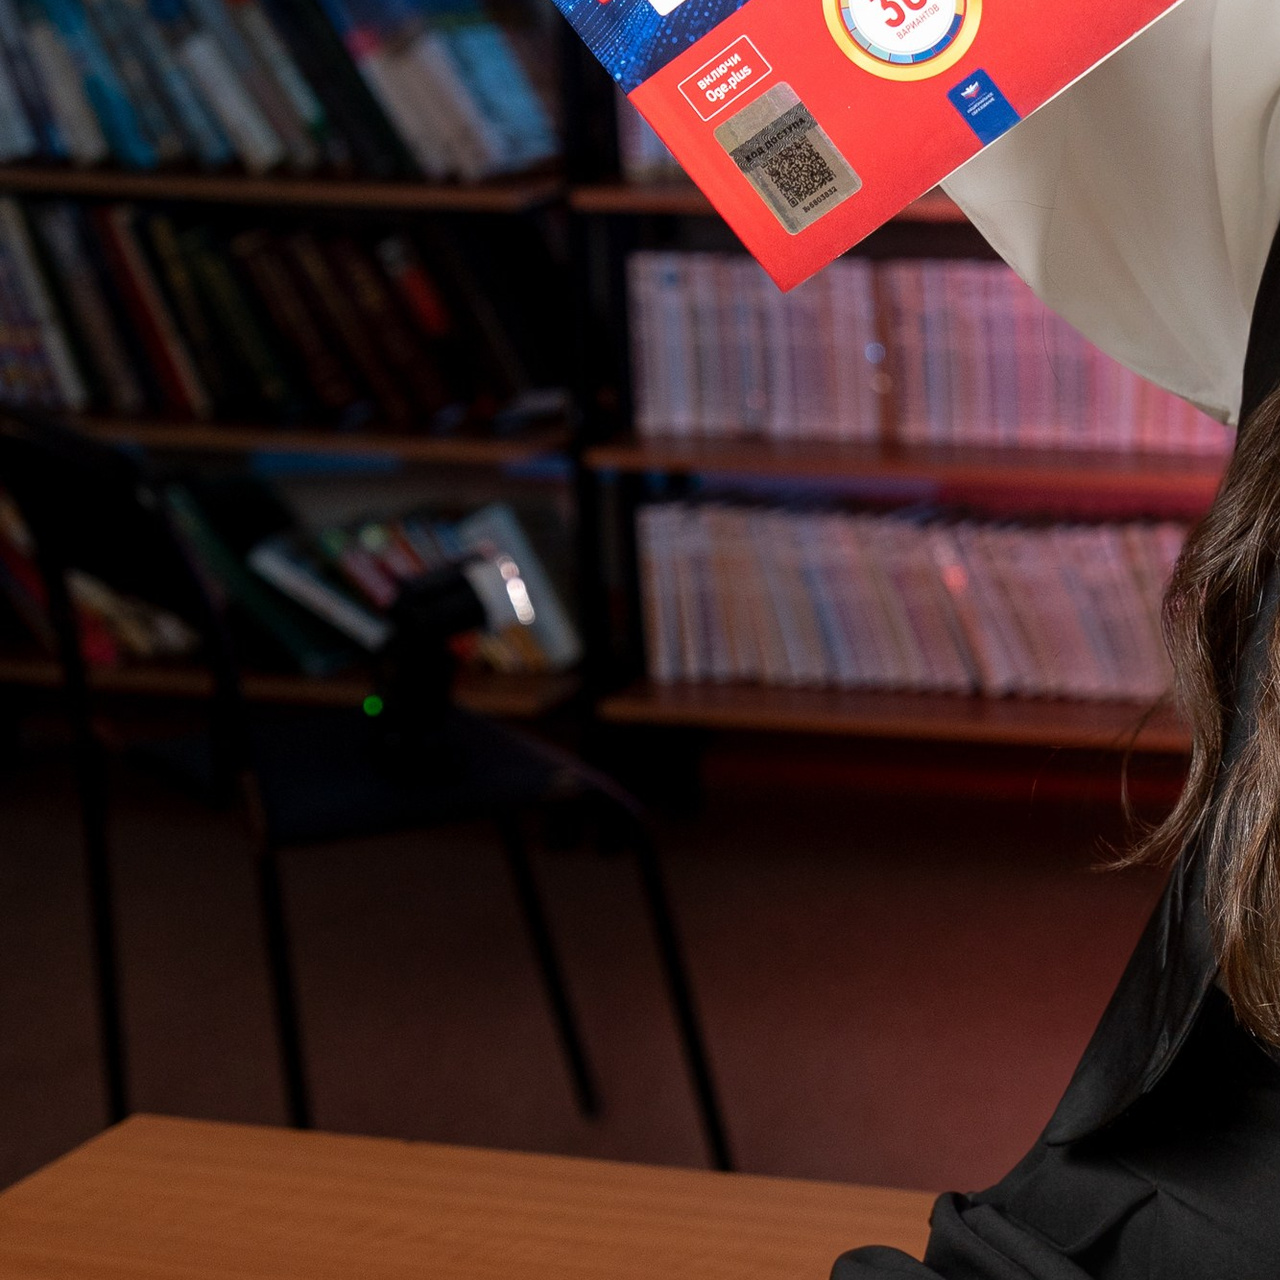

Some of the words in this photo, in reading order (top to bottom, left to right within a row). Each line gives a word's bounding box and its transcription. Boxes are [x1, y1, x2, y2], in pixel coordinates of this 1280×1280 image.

[893, 0, 944, 43] ВАРИАНТОВ
[705, 65, 752, 102] Oge.plus
[743, 145, 766, 165] КОД
[761, 114, 807, 151] ДОСТУПА
